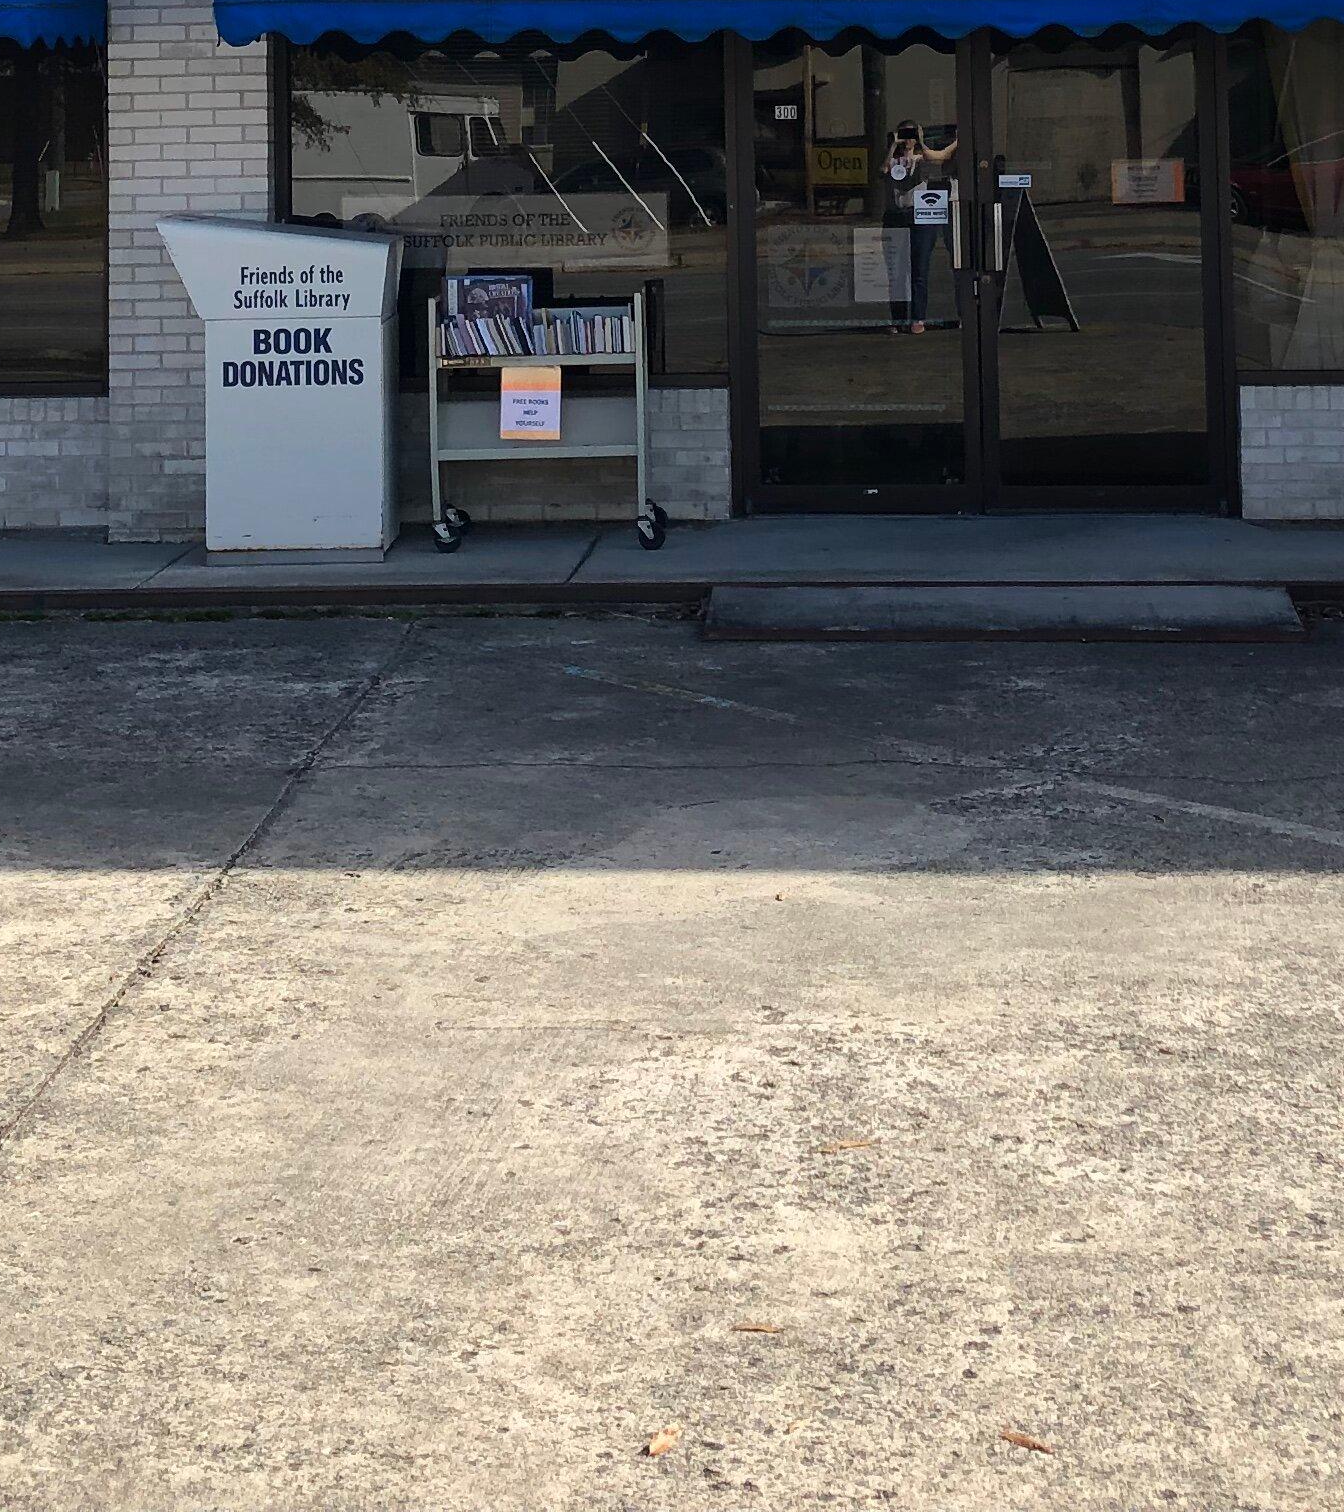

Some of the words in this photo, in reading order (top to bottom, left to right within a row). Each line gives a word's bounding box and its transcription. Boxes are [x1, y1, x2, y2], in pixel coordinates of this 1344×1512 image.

[776, 106, 796, 119] 300
[817, 149, 864, 176] Open
[439, 213, 508, 228] FRIENDS
[512, 213, 536, 227] OF
[537, 213, 572, 227] THE
[402, 234, 475, 249] SUFFOLK
[479, 233, 537, 248] PUBLIC
[541, 233, 609, 247] LIBRARY
[240, 265, 295, 286] Friends
[299, 265, 316, 285] of
[319, 264, 344, 284] the
[233, 289, 289, 310] Suffolk
[295, 288, 351, 311] Library
[253, 327, 333, 355] BOOK
[222, 358, 364, 388] DONATIONS
